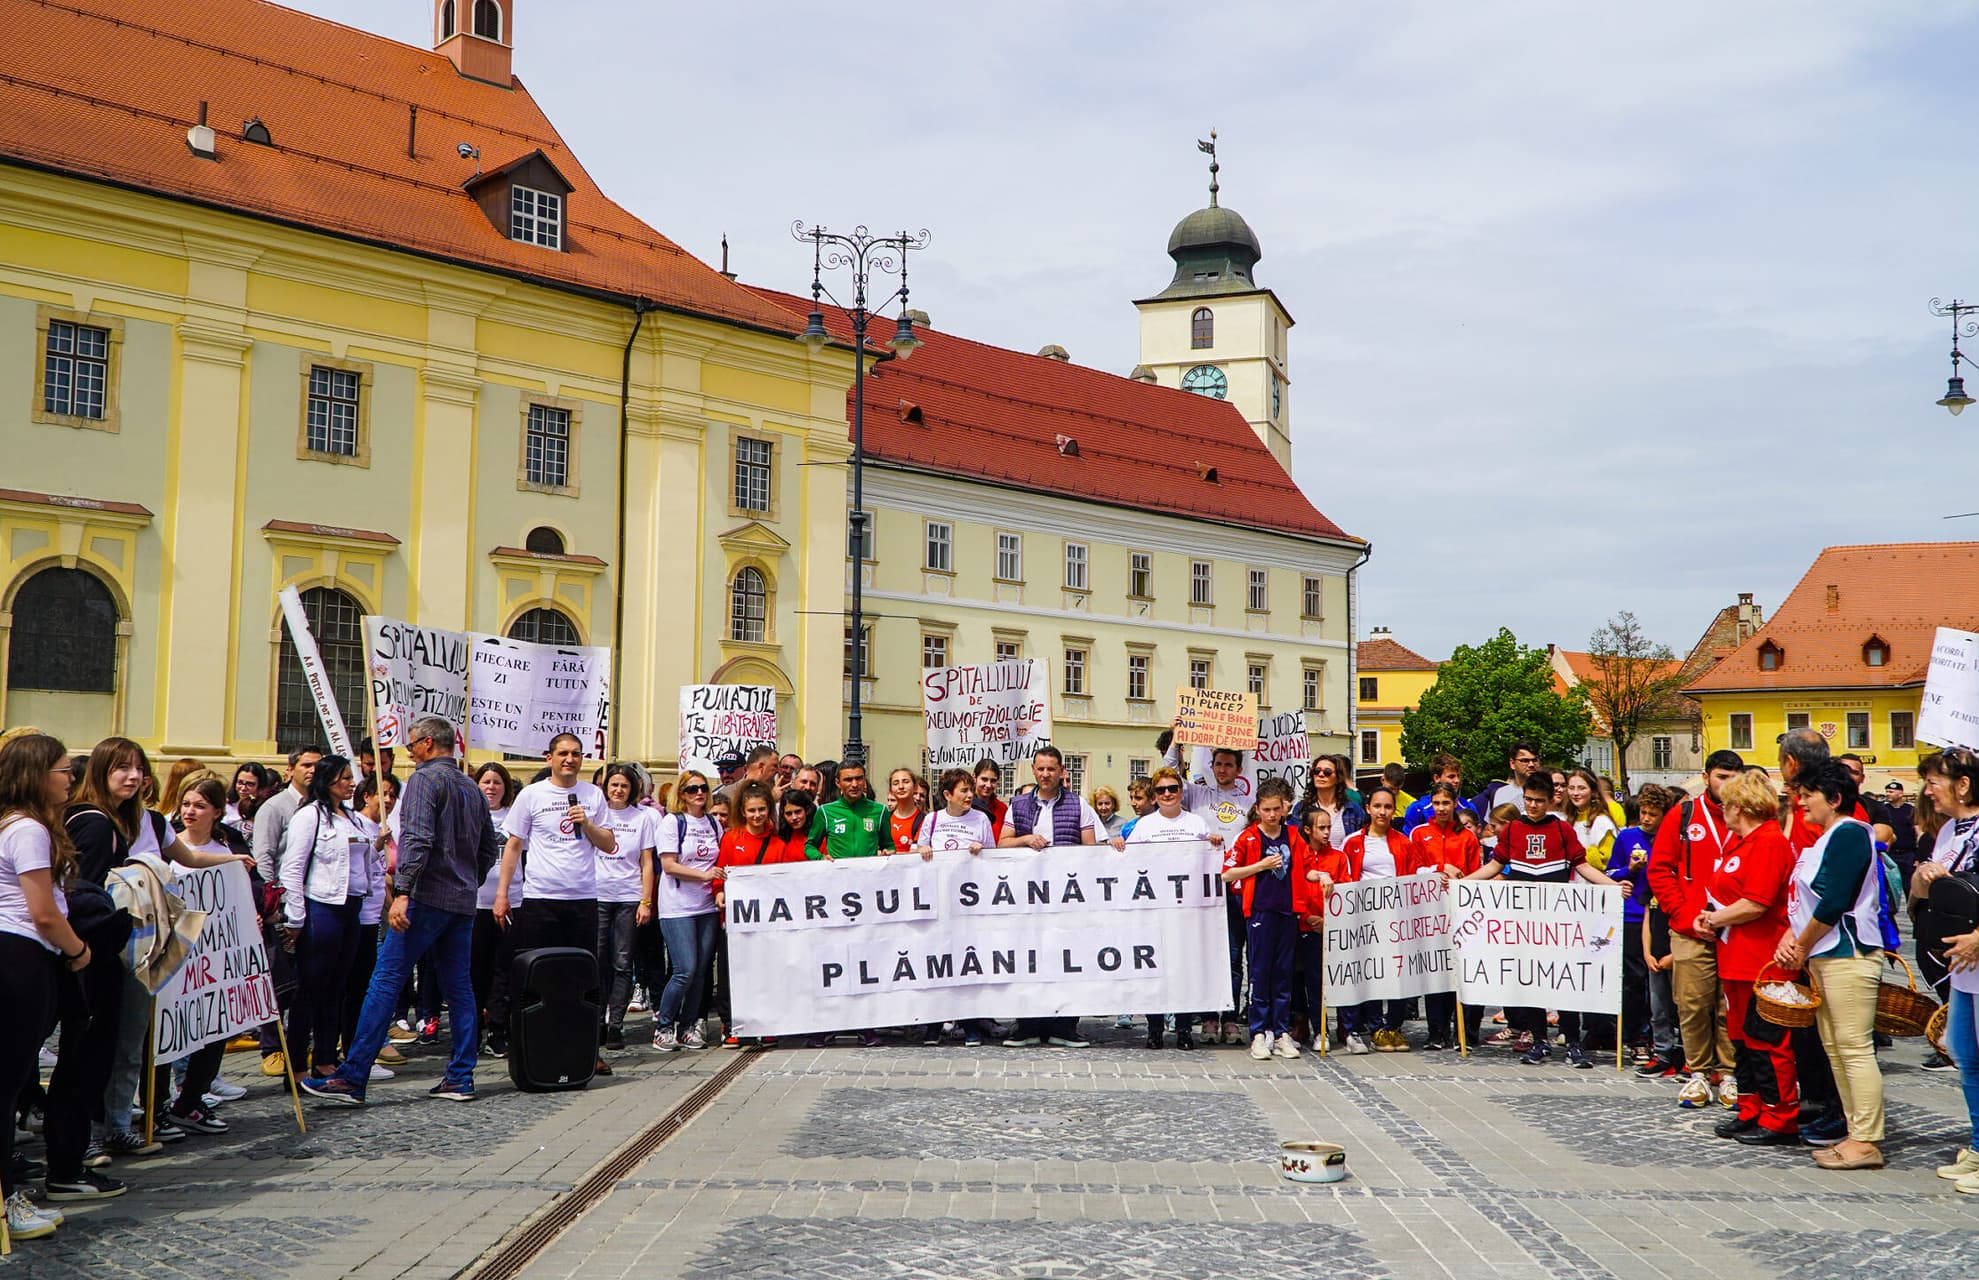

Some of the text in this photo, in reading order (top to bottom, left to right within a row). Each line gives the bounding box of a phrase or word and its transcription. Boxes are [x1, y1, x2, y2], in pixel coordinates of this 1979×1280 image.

[474, 651, 532, 672] FIECARE
[552, 659, 586, 673] FĂRĂ
[493, 672, 507, 685] ZI
[545, 677, 589, 690] TUTUN
[926, 659, 1034, 702] SPITALULUI
[471, 697, 523, 715] ESTE UN
[692, 686, 775, 714] FUMATUL
[969, 695, 983, 706] DE
[1199, 698, 1244, 713] PLACE?
[541, 711, 586, 722] PENTRU
[686, 712, 706, 733] TE
[1227, 712, 1255, 726] BINE
[1225, 724, 1254, 737] BINE
[834, 823, 847, 834] 29
[732, 886, 931, 924] MARȘUL
[1328, 892, 1343, 917] O
[1363, 957, 1385, 981] CU
[1391, 954, 1404, 978] 7
[1463, 958, 1490, 985] LA
